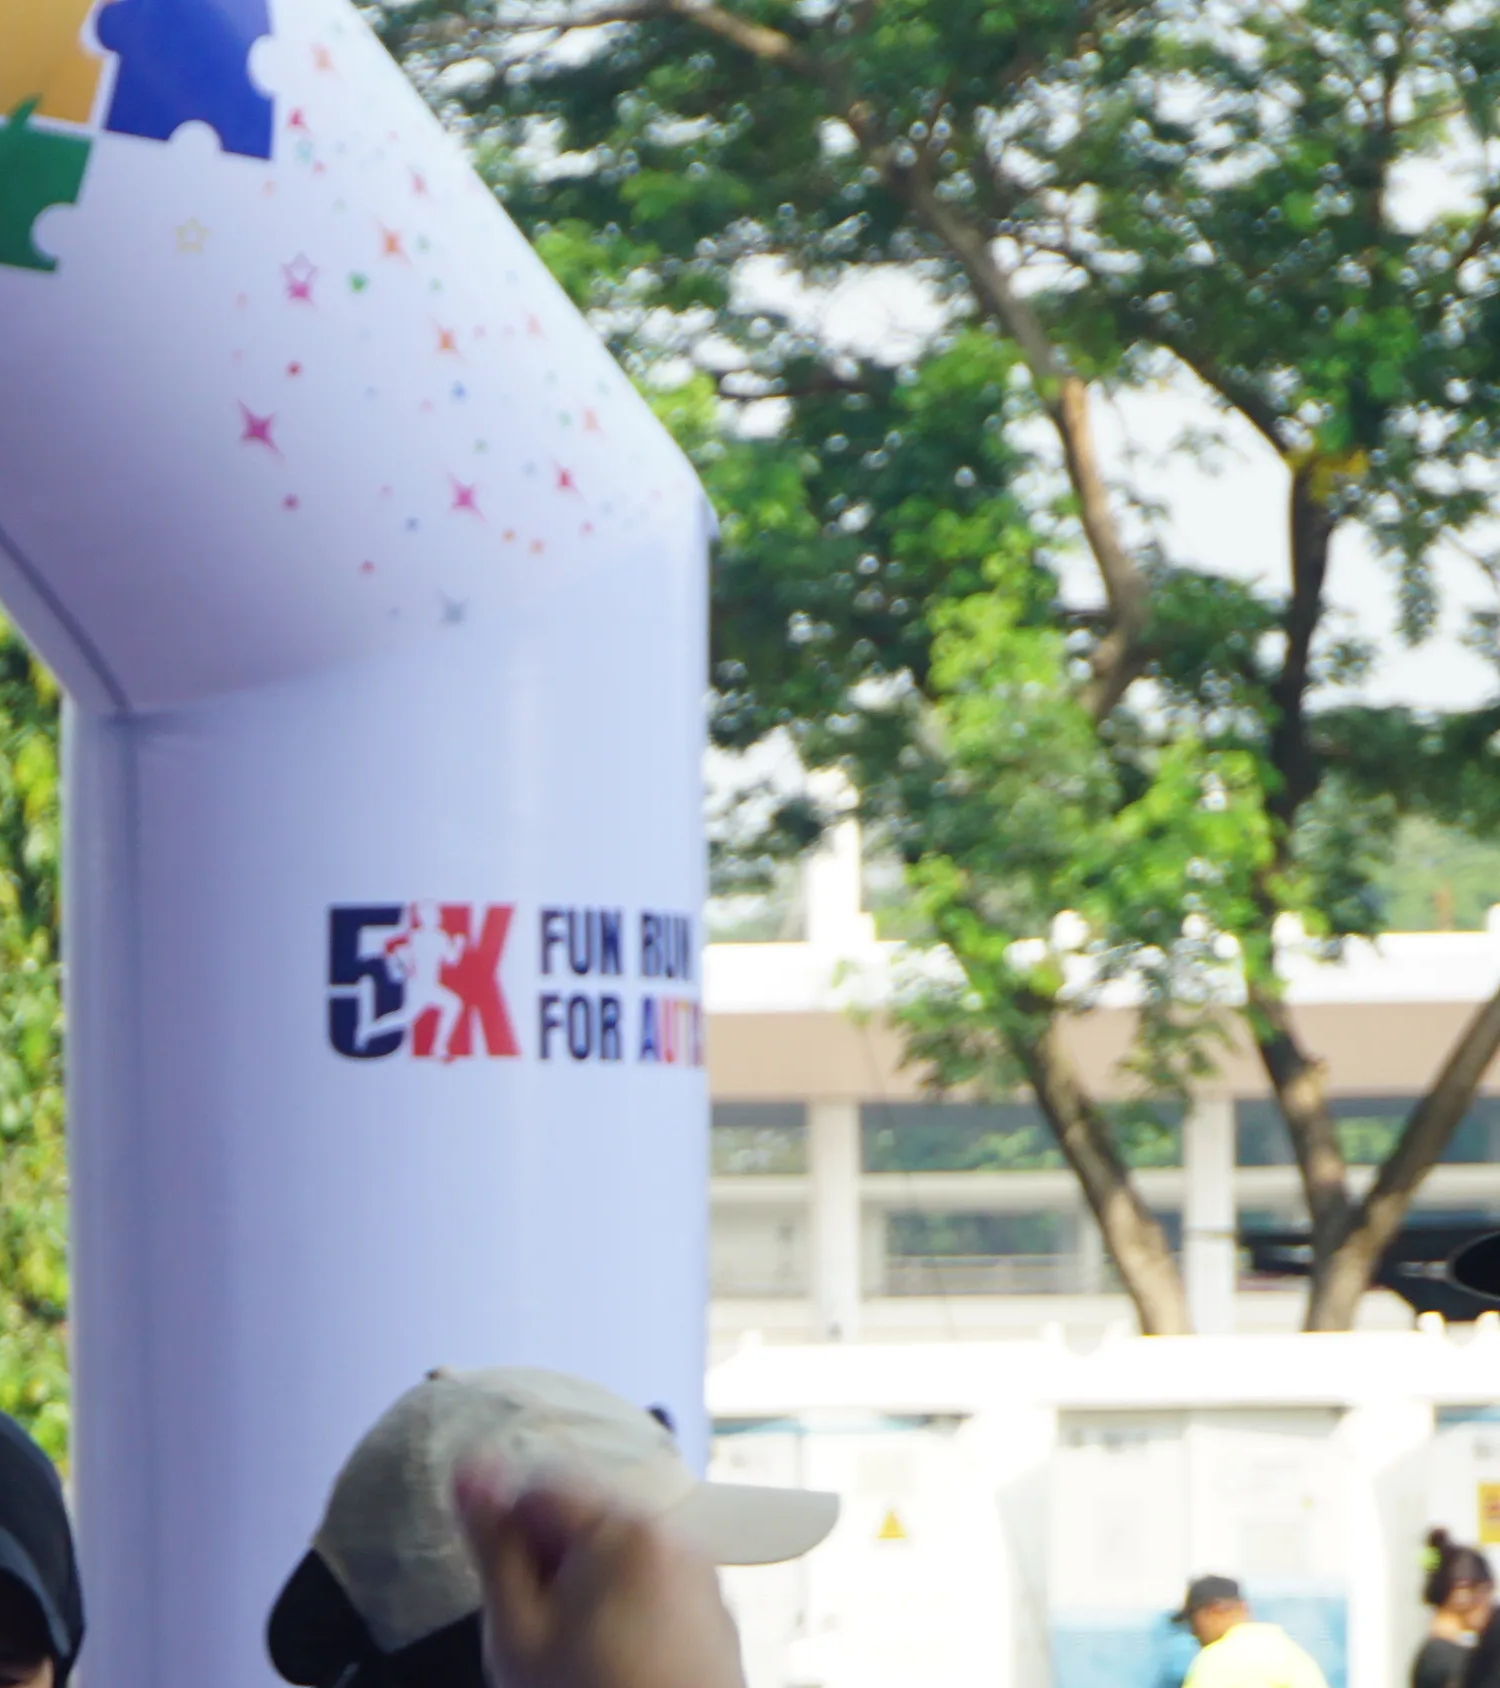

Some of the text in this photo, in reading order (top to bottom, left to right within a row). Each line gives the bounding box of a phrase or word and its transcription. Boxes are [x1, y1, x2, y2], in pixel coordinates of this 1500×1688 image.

[538, 908, 695, 982] FUN RUN
[538, 993, 623, 1063] FOR
